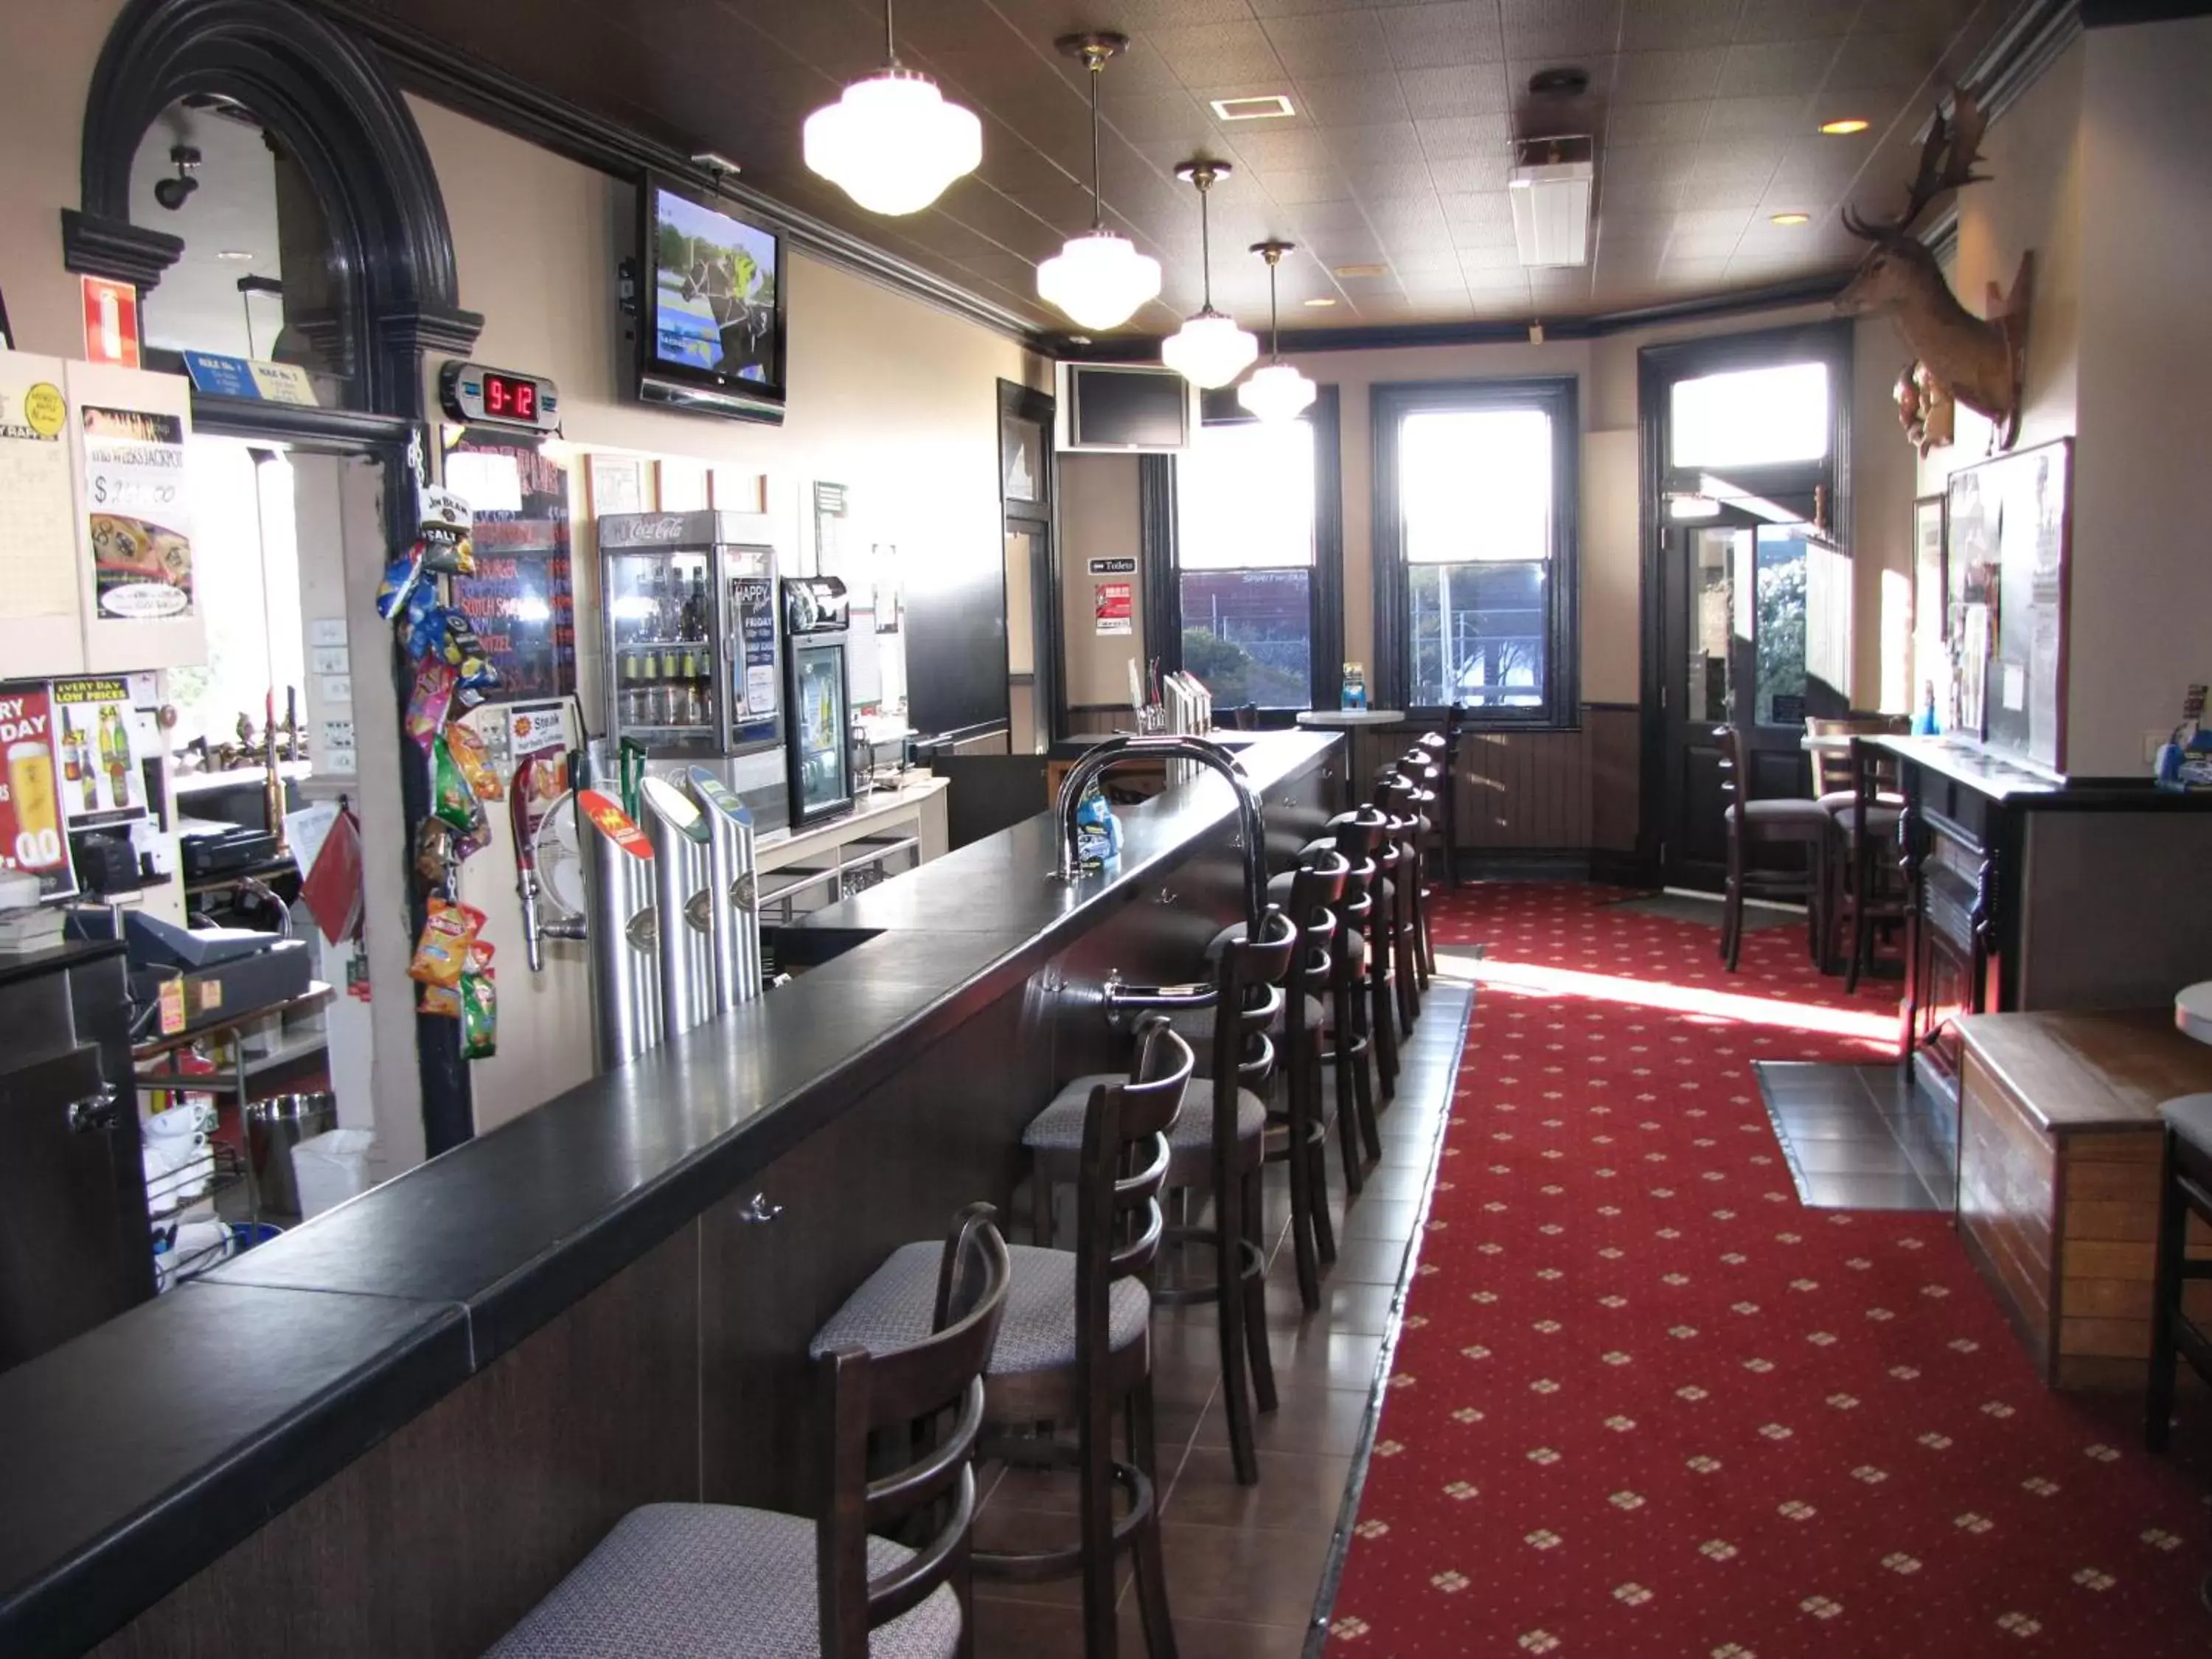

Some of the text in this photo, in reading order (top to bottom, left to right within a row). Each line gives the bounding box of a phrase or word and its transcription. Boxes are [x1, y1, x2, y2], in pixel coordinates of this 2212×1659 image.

[736, 585, 768, 602] HAPPY
[745, 618, 772, 627] FRIDAY
[97, 681, 121, 689] DAY
[57, 689, 126, 702] LOW PRICES
[0, 714, 46, 742] DAY
